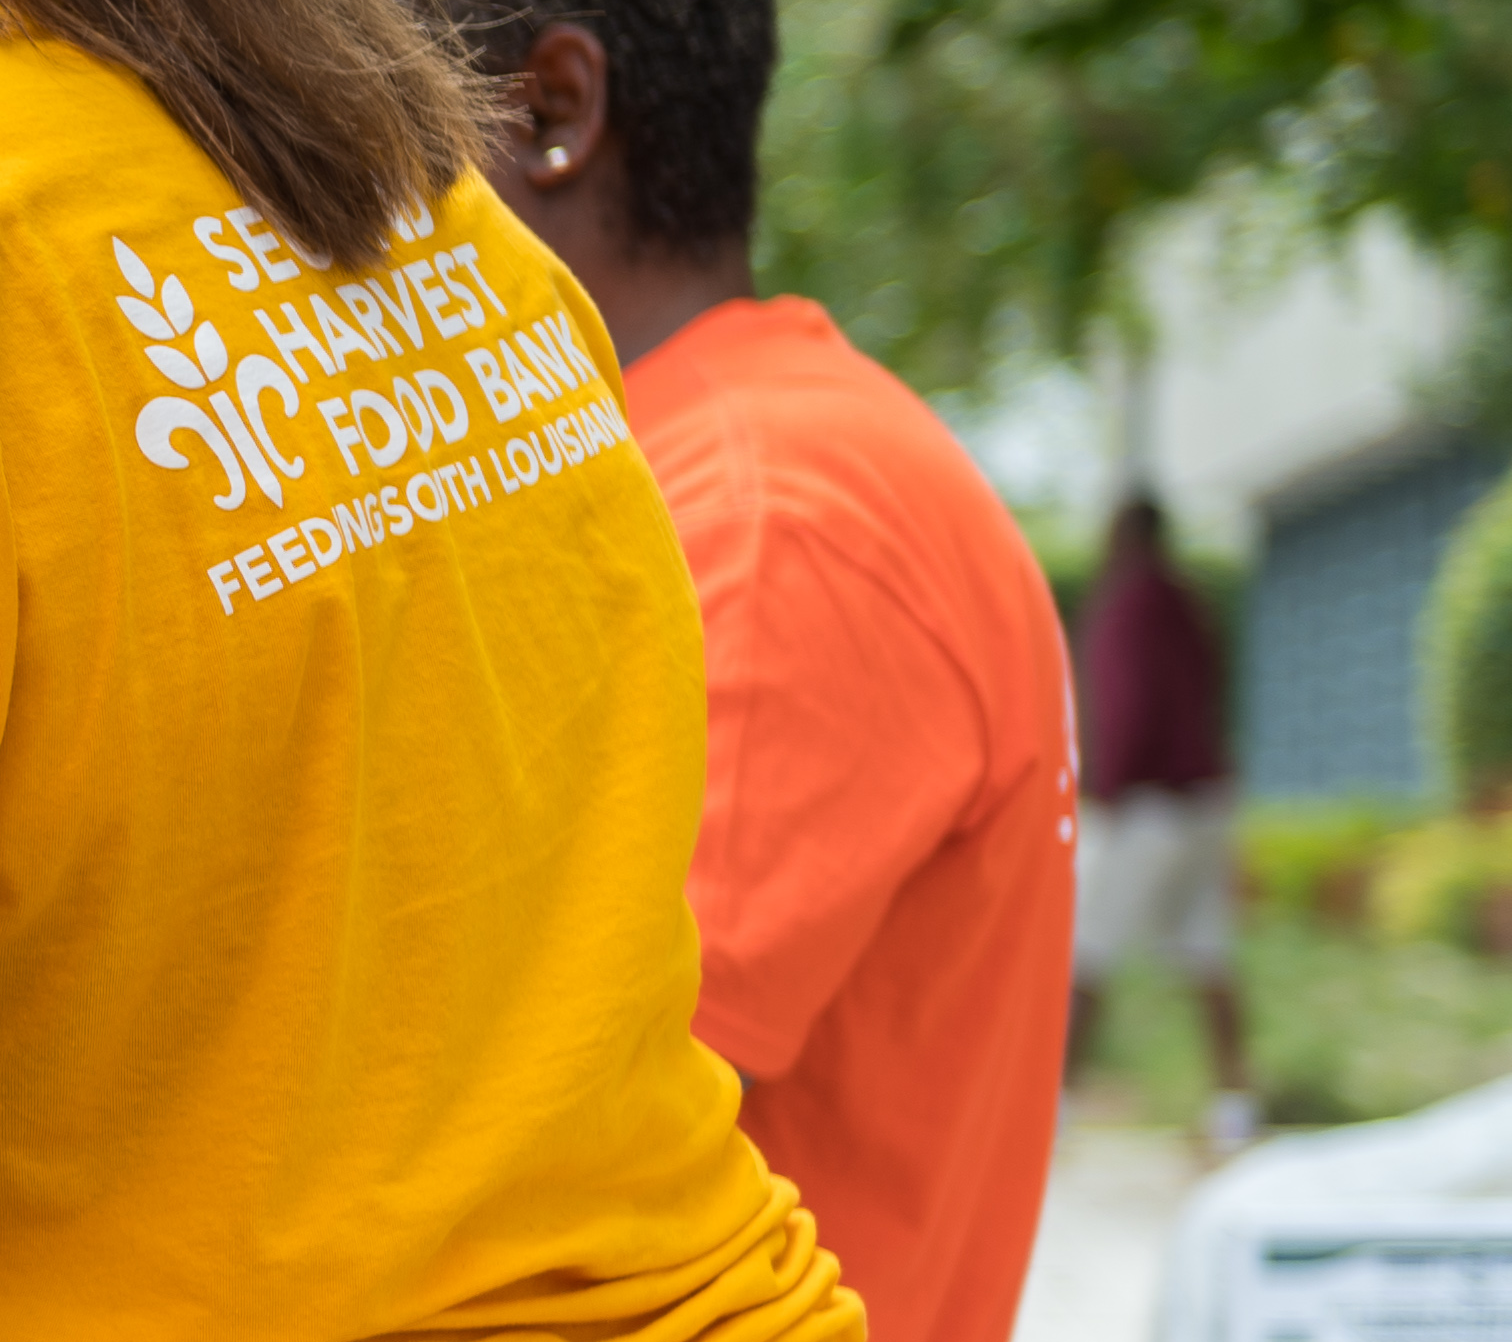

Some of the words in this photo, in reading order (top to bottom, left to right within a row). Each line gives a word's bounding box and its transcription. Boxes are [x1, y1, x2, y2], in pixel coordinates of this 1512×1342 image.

[253, 242, 507, 384] HARVEST
[316, 369, 469, 476] FOOD
[464, 311, 599, 423] BANK
[379, 456, 493, 536] SOTH
